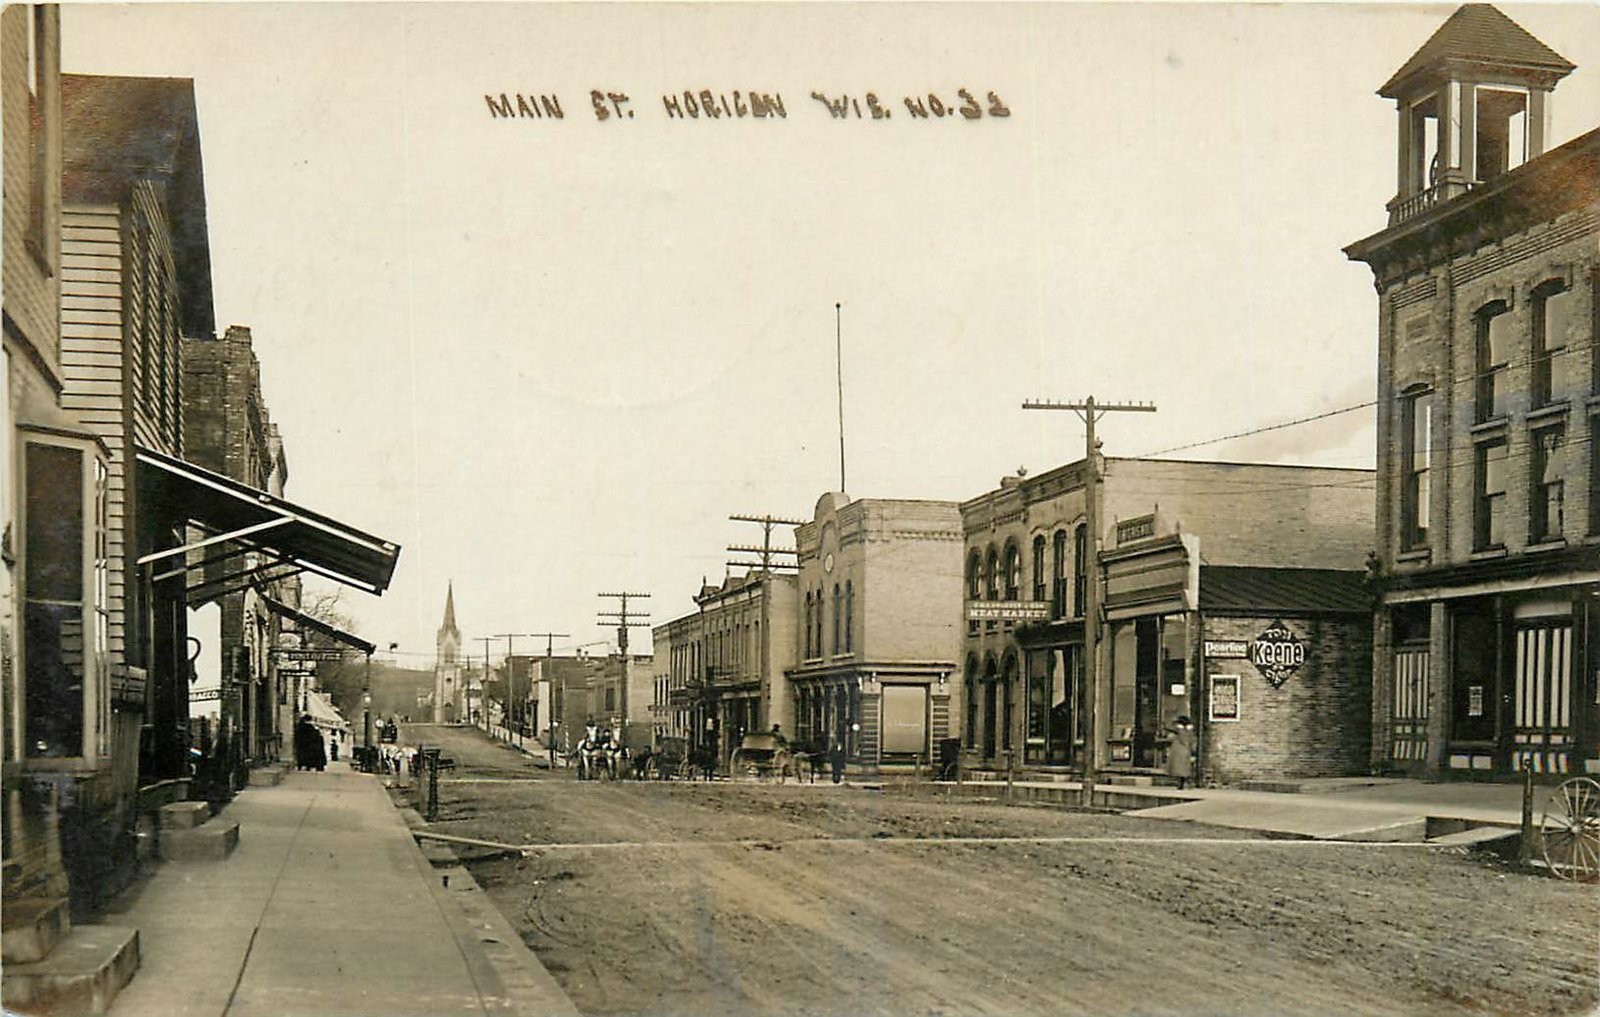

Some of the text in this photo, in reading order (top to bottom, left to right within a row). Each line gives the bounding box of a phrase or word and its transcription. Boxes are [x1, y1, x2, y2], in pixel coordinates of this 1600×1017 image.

[970, 609, 1048, 617] MEAT MARKET
[1253, 641, 1305, 666] Keene
